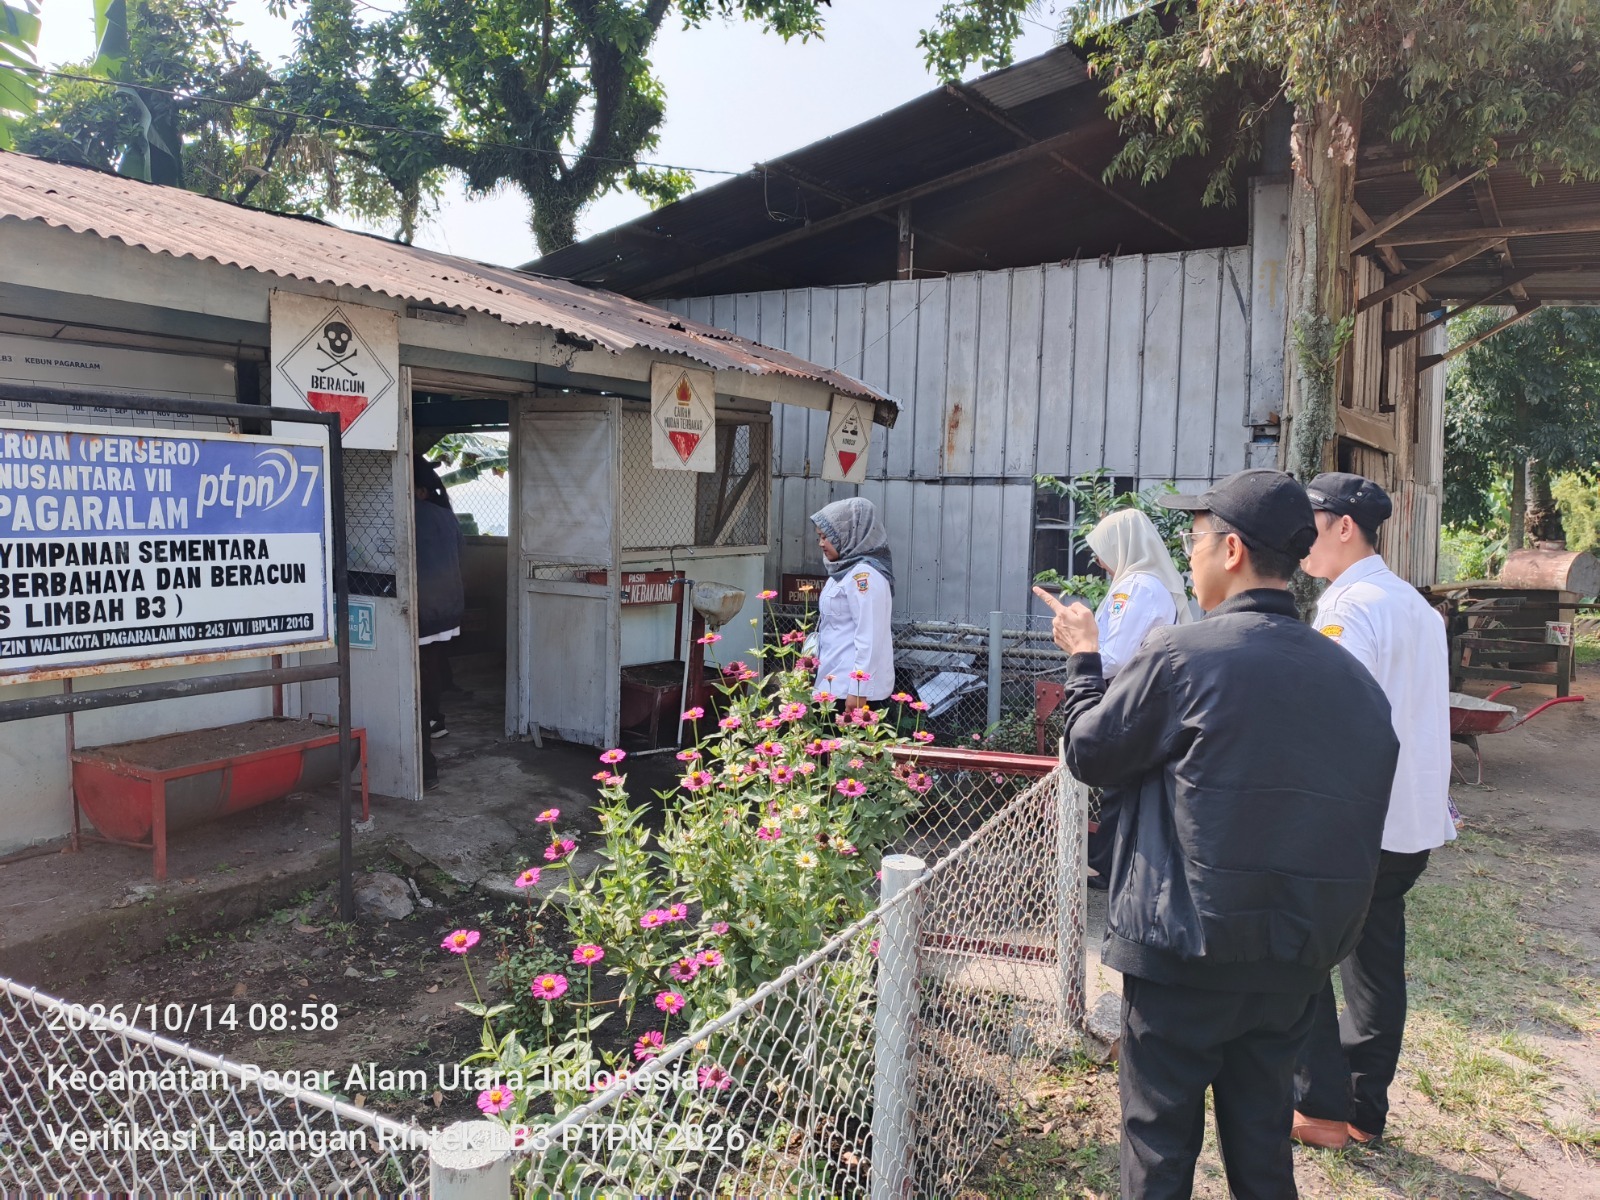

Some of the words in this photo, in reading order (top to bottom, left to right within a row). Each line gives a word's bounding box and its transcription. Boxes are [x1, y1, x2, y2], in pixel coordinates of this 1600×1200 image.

[25, 357, 52, 366] KEBUN
[54, 359, 101, 370] PAGARALAM
[311, 375, 365, 394] BERACUN
[0, 432, 71, 461] ROAN
[79, 437, 200, 467] (PERSERO)
[0, 463, 136, 492] NUSANTARA
[144, 468, 172, 492] VII
[196, 463, 275, 518] ptpn
[300, 465, 319, 507] 7
[0, 494, 188, 532] PAGARALAM
[0, 541, 130, 568] YIMPANAN
[138, 539, 270, 563] SEMENTARA
[0, 568, 145, 599] BERBAHAYA
[157, 566, 201, 590] DAN
[211, 563, 306, 587] BERACUN
[629, 573, 646, 583] PASIR
[631, 583, 673, 603] KEBAKARAN
[25, 598, 124, 628] LIMBAH
[136, 596, 166, 620] B3
[0, 639, 26, 656] ZIN
[31, 633, 99, 653] WALIKOTA
[103, 627, 176, 647] PAGARALAM
[179, 625, 196, 640] NO
[205, 622, 225, 637] 243
[232, 620, 244, 636] VI
[252, 616, 279, 633] BPLH
[286, 615, 310, 629] 2016
